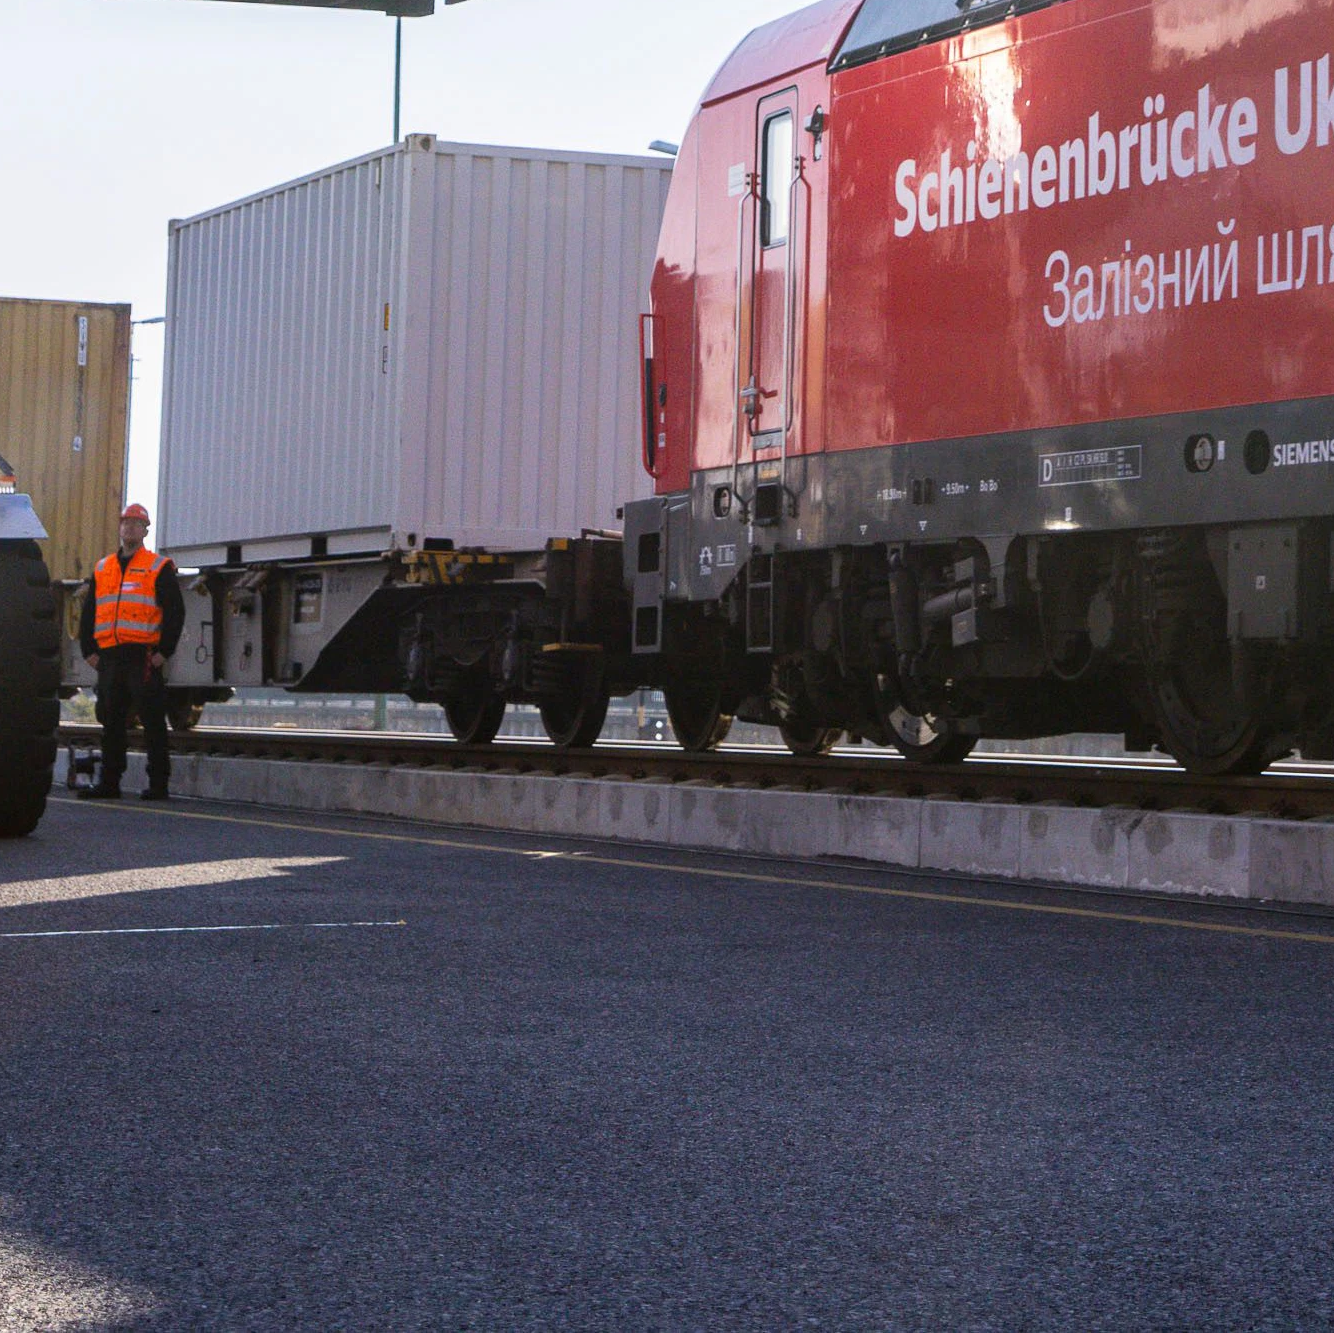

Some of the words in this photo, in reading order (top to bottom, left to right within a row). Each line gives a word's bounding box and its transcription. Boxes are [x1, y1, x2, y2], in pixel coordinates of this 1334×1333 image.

[894, 82, 1258, 238] Schienenbrücke
[1043, 219, 1240, 328] Залізний
[1043, 458, 1053, 482] D
